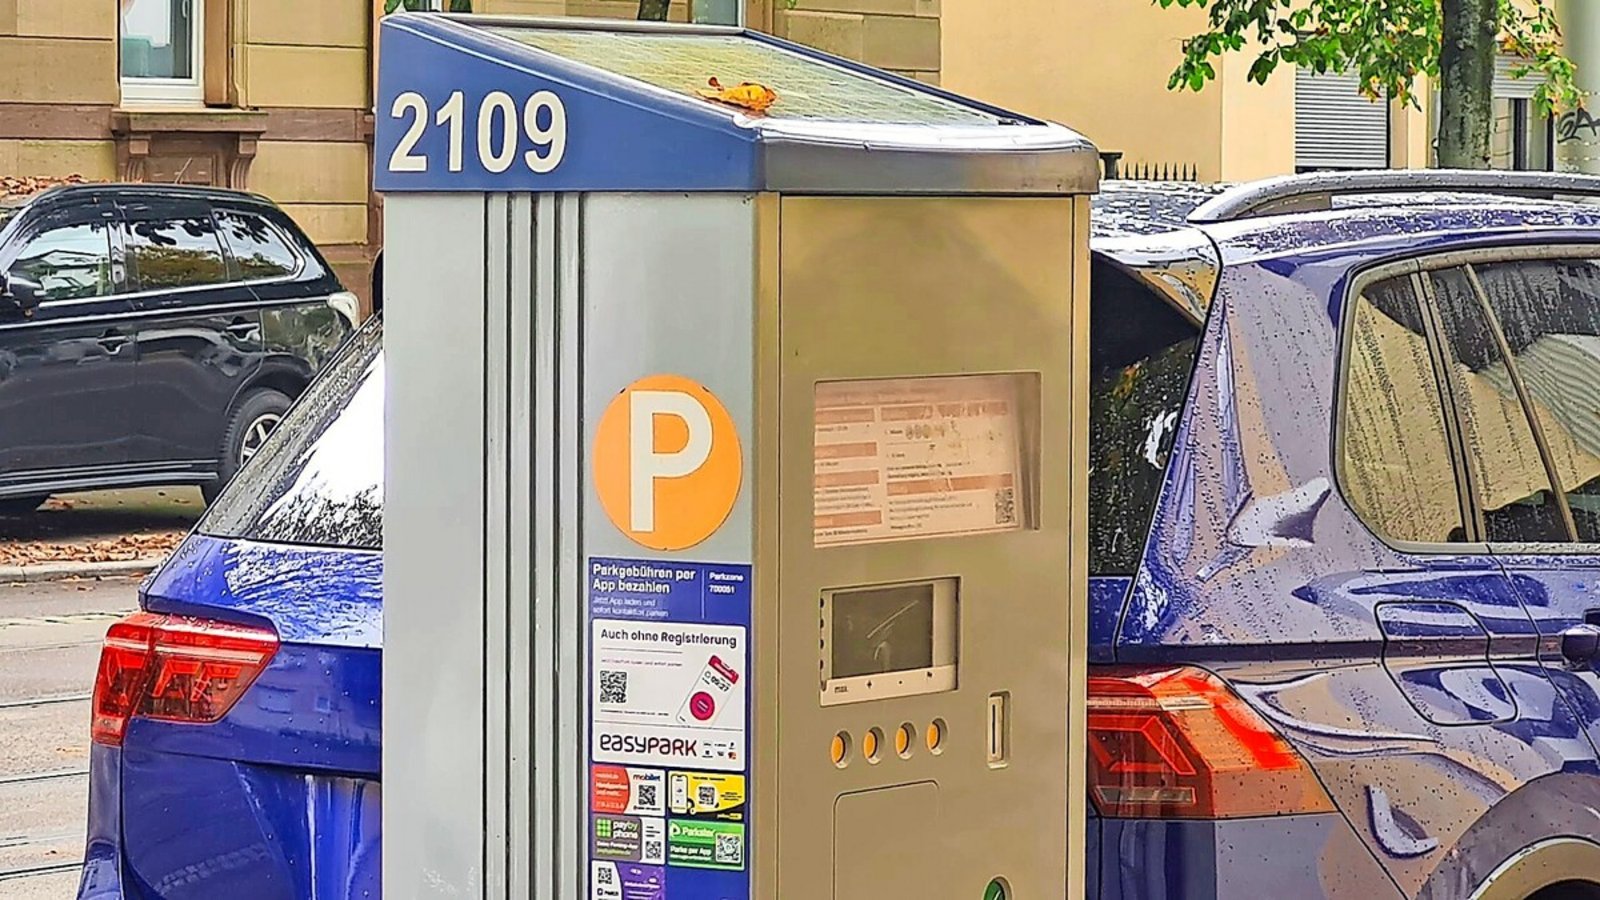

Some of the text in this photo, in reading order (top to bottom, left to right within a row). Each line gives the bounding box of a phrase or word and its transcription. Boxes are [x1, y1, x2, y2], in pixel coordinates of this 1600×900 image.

[388, 90, 567, 173] 2109
[630, 390, 713, 533] P
[593, 563, 697, 583] Parkgebühren per
[708, 571, 744, 582] Parkzone
[593, 579, 670, 594] App bezahlen
[601, 628, 737, 648] Auch ohne Registrierung
